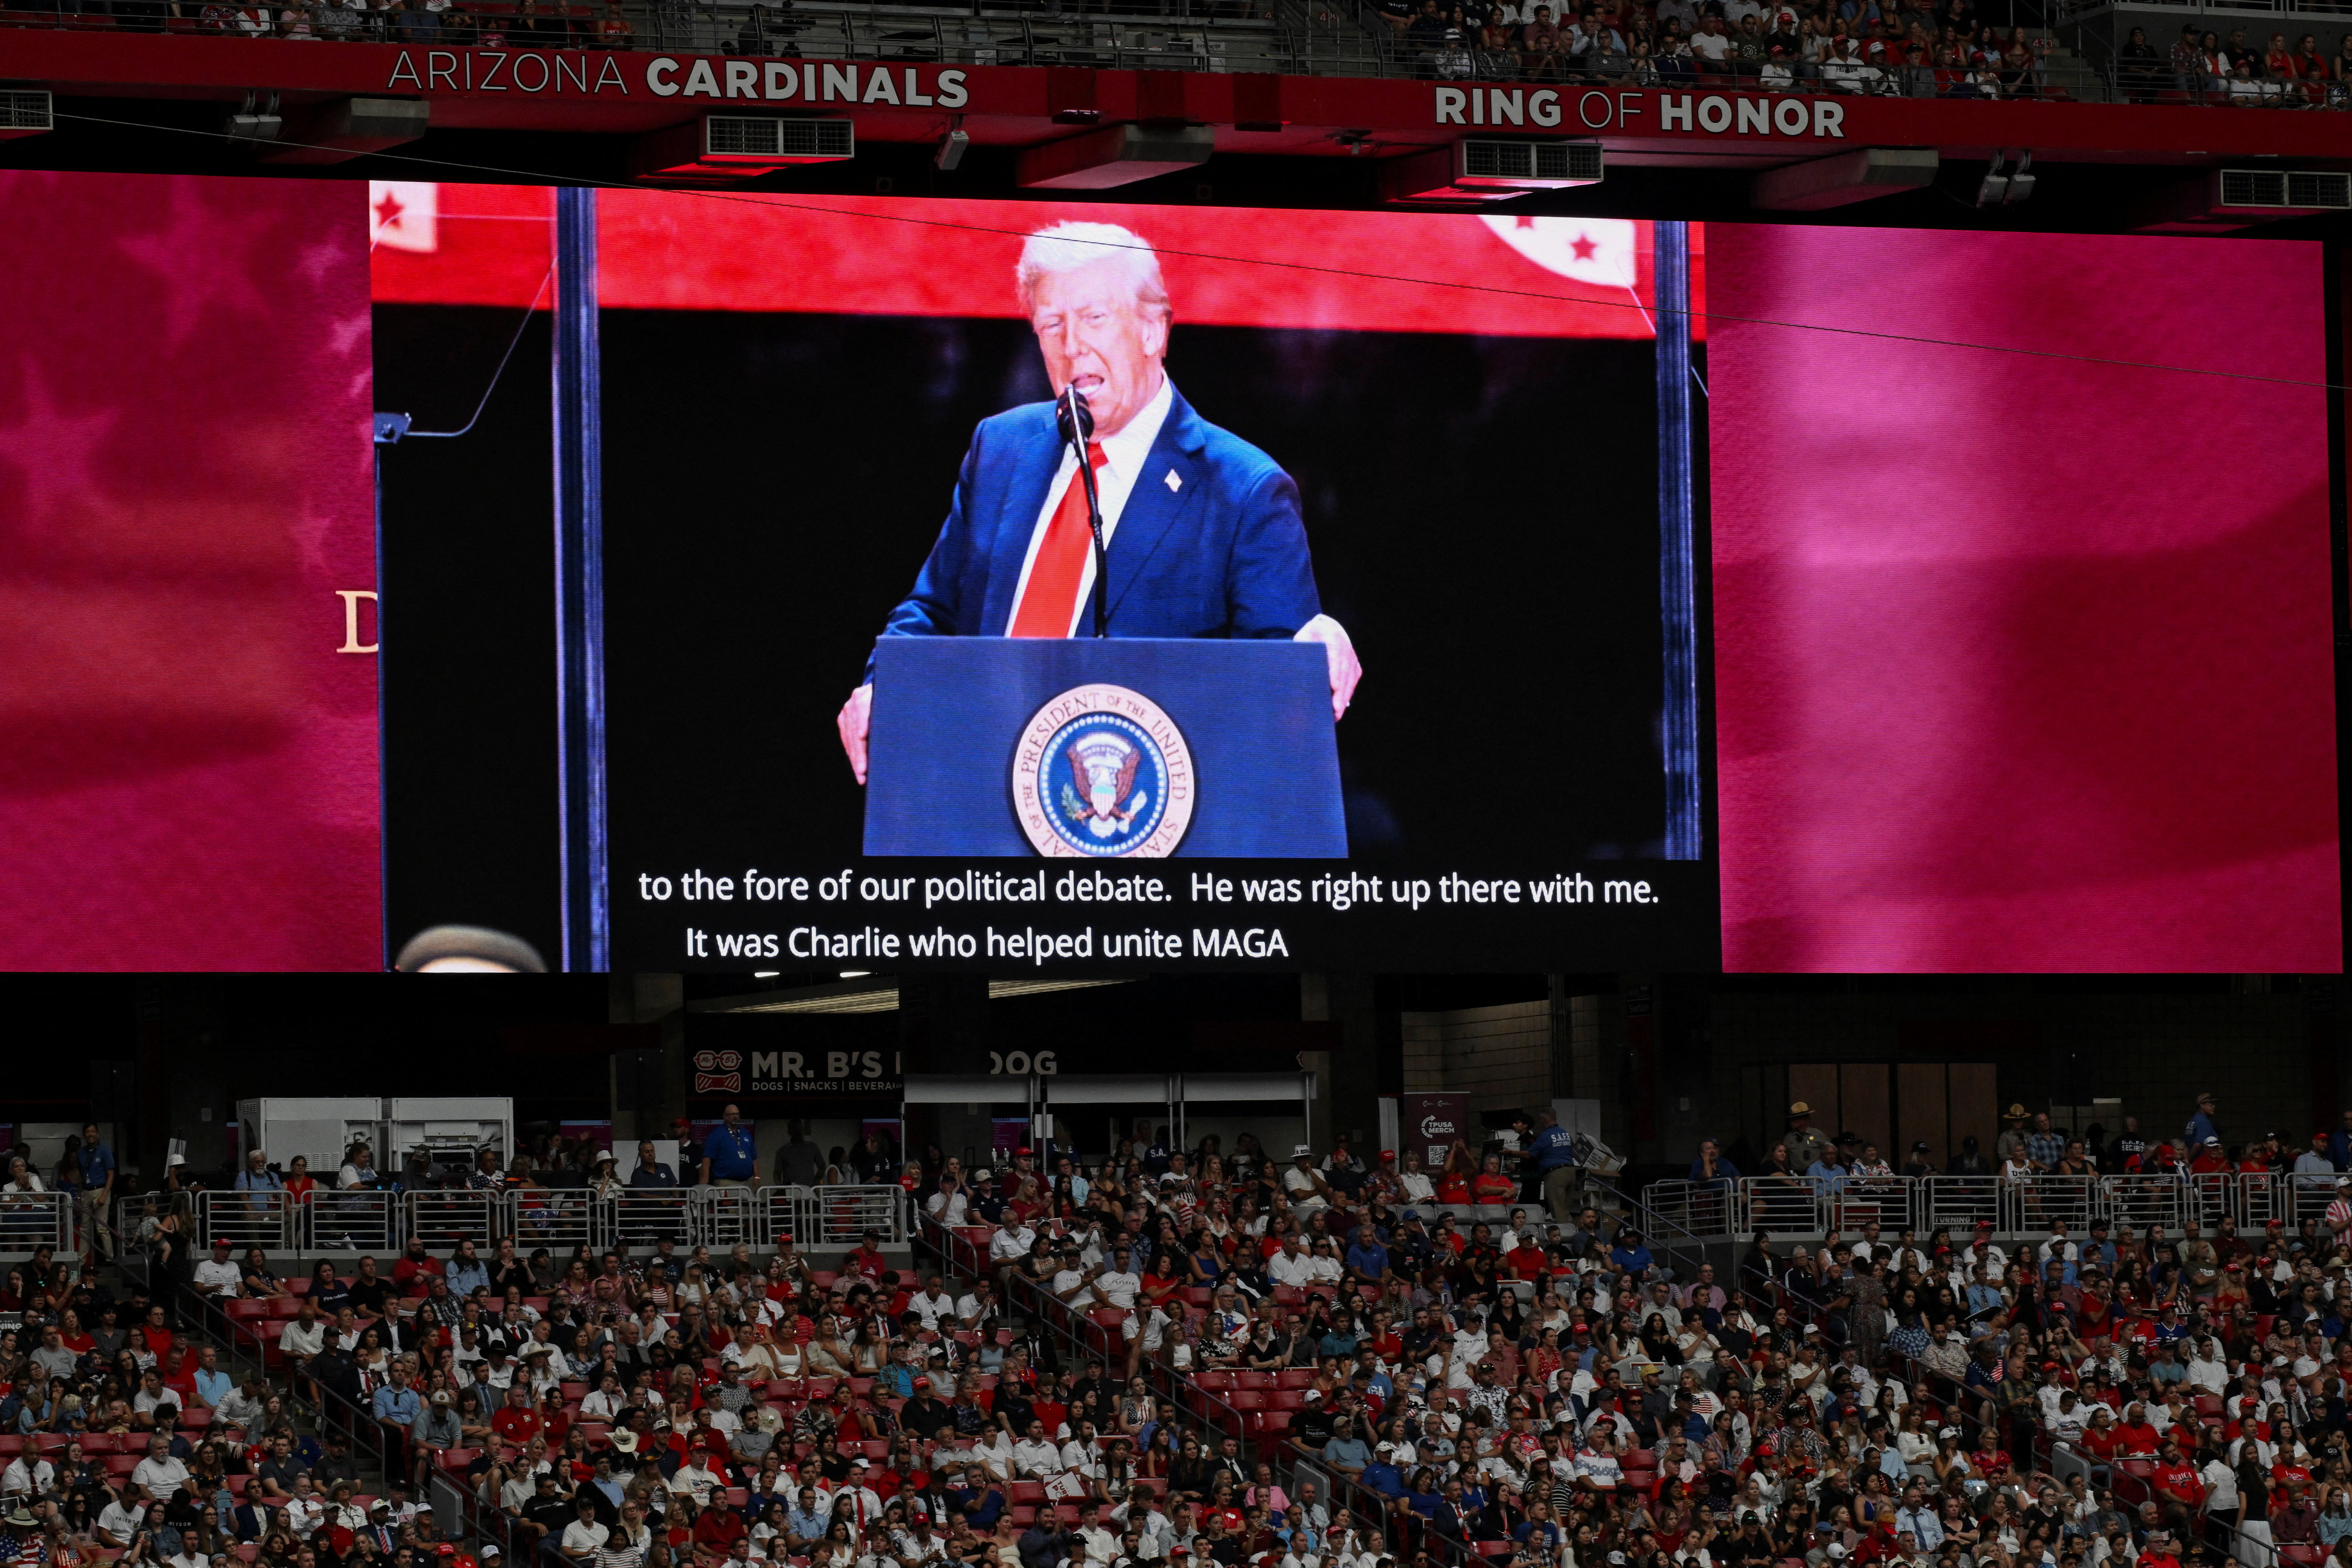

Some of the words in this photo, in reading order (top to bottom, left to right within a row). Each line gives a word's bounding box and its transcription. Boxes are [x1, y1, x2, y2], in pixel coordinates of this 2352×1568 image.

[387, 50, 628, 94] ARIZONA
[646, 57, 969, 108] CARDINALS
[1435, 87, 1561, 127] RING
[1579, 91, 1643, 128] OF
[1661, 94, 1846, 138] HONOR
[1107, 695, 1121, 706] OF
[1126, 700, 1146, 719] THE
[1021, 693, 1100, 774] PRESIDENT
[1152, 720, 1186, 800] UNITED
[1022, 785, 1034, 807] THE
[639, 873, 672, 900] to
[681, 869, 734, 900] the
[743, 869, 809, 900] fore
[819, 869, 853, 900] of
[860, 877, 916, 900] our
[925, 870, 1045, 909] political
[1056, 870, 1171, 901] debate.
[1192, 873, 1233, 901] He
[1242, 879, 1302, 901] was
[1312, 871, 1383, 910] right
[1392, 880, 1430, 910] up
[1439, 872, 1521, 902] there
[1529, 873, 1593, 903] with
[1604, 880, 1658, 903] me.
[687, 928, 708, 957] It
[716, 934, 779, 957] was
[789, 926, 900, 957] Charlie
[909, 926, 976, 957] who
[987, 927, 1092, 966] helped
[1104, 928, 1182, 957] unite
[1193, 928, 1288, 957] MAGA
[752, 1051, 814, 1078] MR.
[827, 1051, 883, 1078] B'S
[752, 1082, 783, 1090] DOGS
[794, 1081, 838, 1091] SNACKS
[848, 1082, 895, 1091] BEVERA
[679, 1153, 690, 1163] SA
[1150, 1148, 1167, 1158] S.A.
[2168, 1471, 2192, 1481] AMERICA
